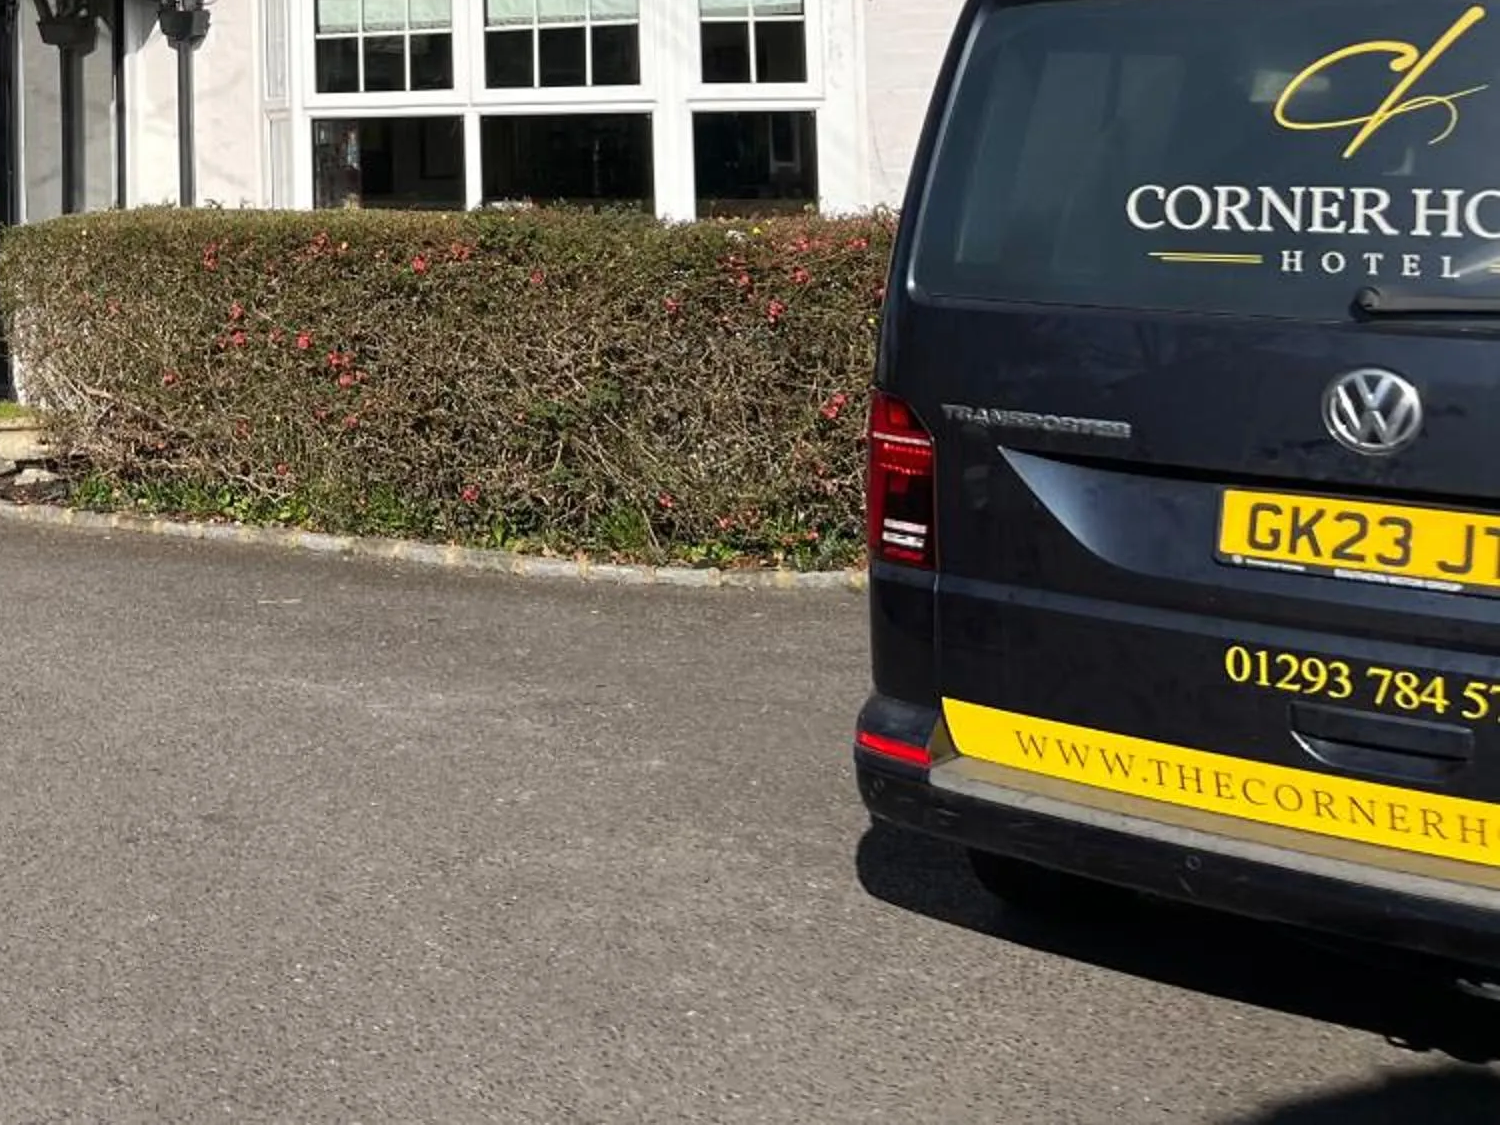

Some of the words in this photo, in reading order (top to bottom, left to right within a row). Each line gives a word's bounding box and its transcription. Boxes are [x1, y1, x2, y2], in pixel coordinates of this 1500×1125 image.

[1126, 184, 1400, 236] CORNER
[1410, 188, 1500, 240] HO
[1280, 249, 1461, 278] HOTEL
[1247, 502, 1414, 568] GK23
[1225, 645, 1353, 699] 01293
[1366, 666, 1451, 715] 784
[1014, 729, 1500, 849] WWW.THECORNERH
